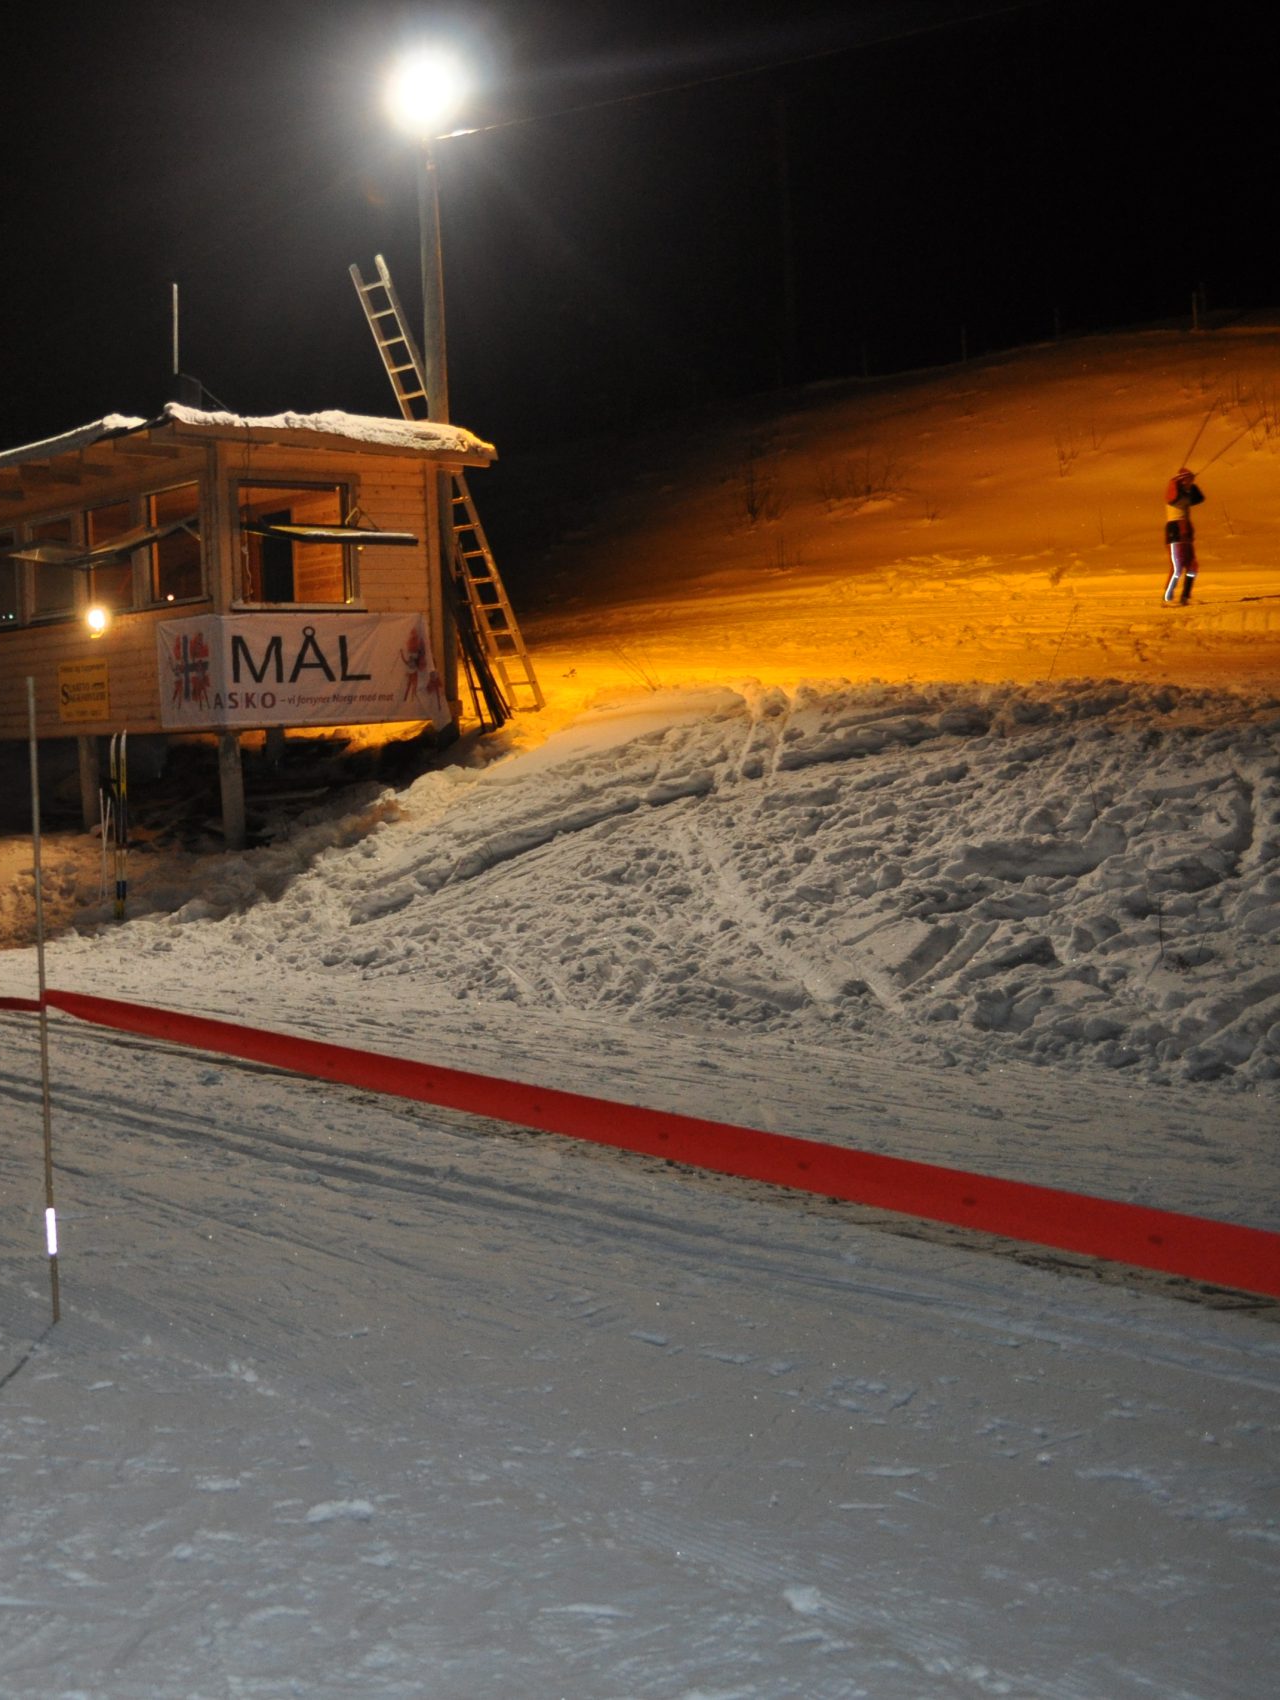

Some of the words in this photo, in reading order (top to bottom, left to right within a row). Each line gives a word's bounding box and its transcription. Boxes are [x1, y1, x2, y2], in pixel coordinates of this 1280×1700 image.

[231, 626, 372, 684] MÅL
[213, 691, 276, 709] ASKO
[288, 694, 296, 704] vi
[358, 692, 377, 702] med
[378, 692, 395, 702] mat
